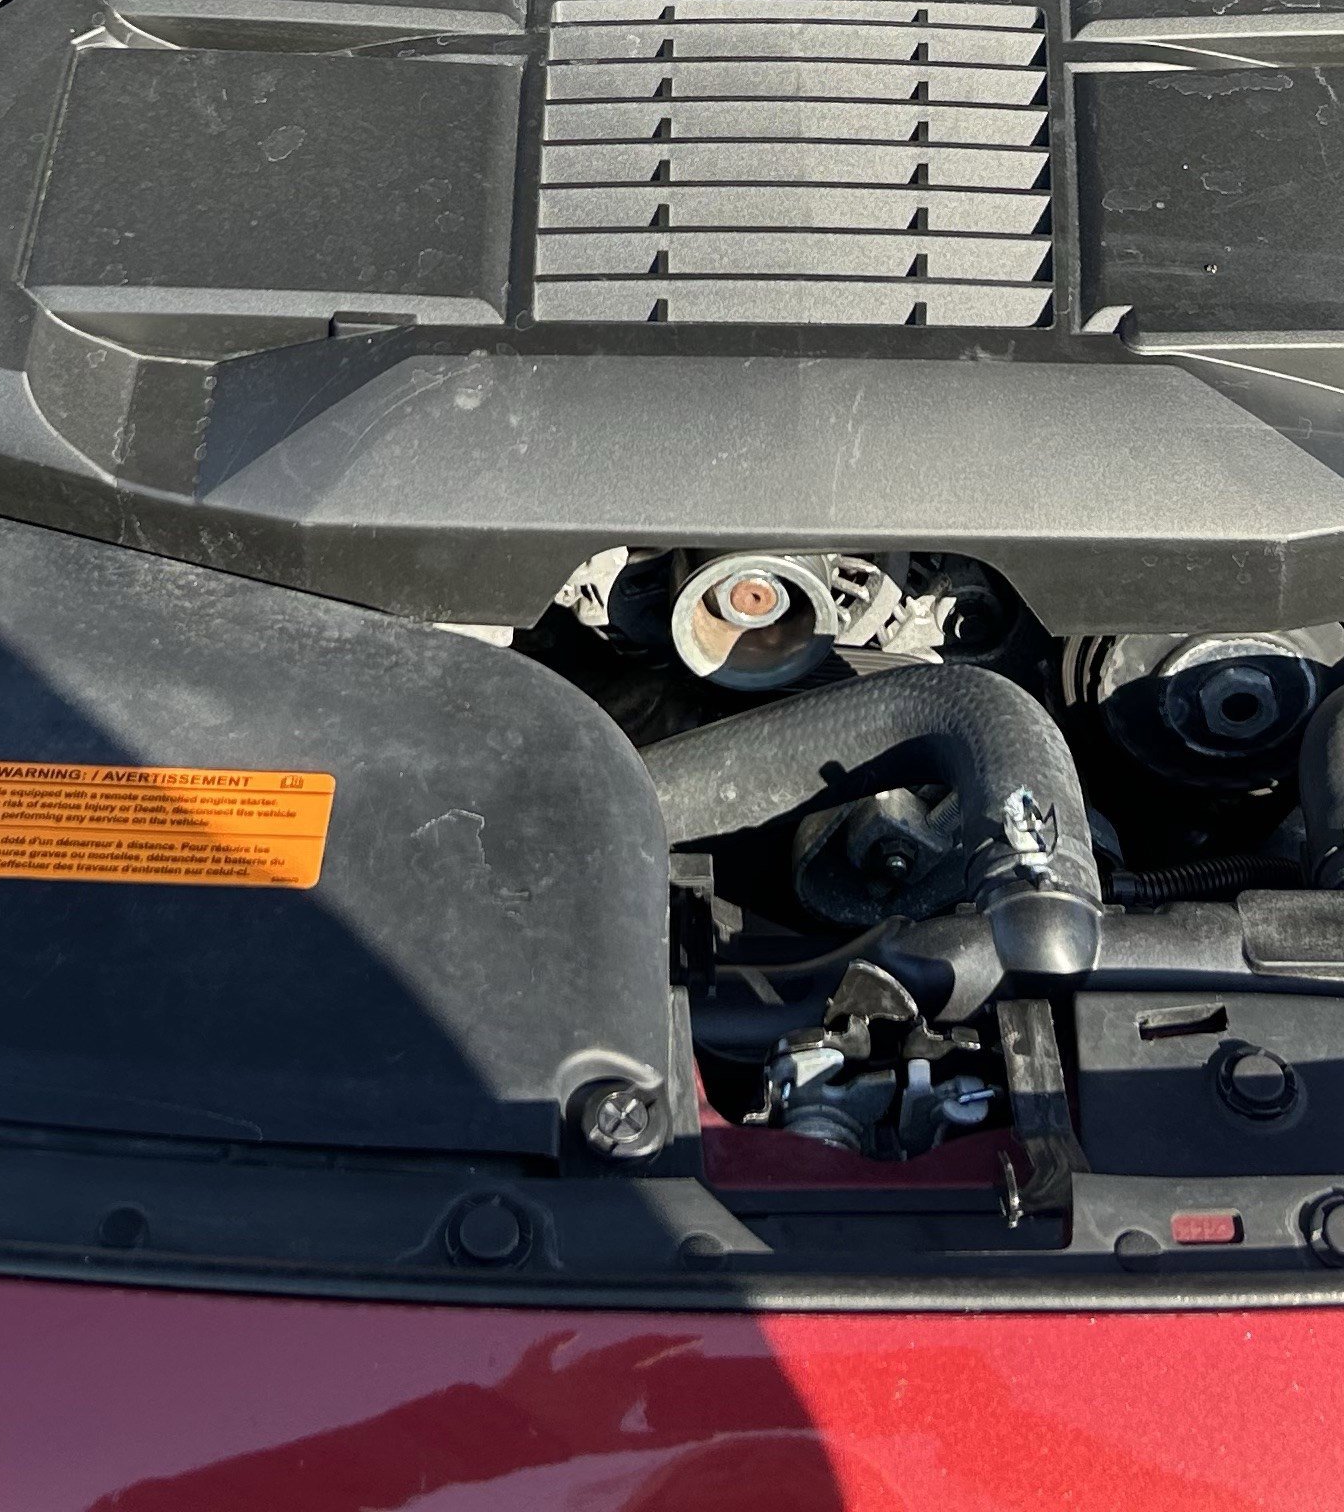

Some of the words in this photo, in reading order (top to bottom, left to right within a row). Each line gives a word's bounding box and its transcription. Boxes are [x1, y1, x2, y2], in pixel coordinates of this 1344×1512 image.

[102, 770, 253, 787] AVERTISSEMENT
[10, 788, 62, 800] equipped
[65, 789, 88, 799] with
[100, 792, 138, 801] remote
[141, 793, 197, 804] controlled
[200, 796, 237, 806] engine
[1, 810, 63, 823] performing
[89, 813, 130, 824] service
